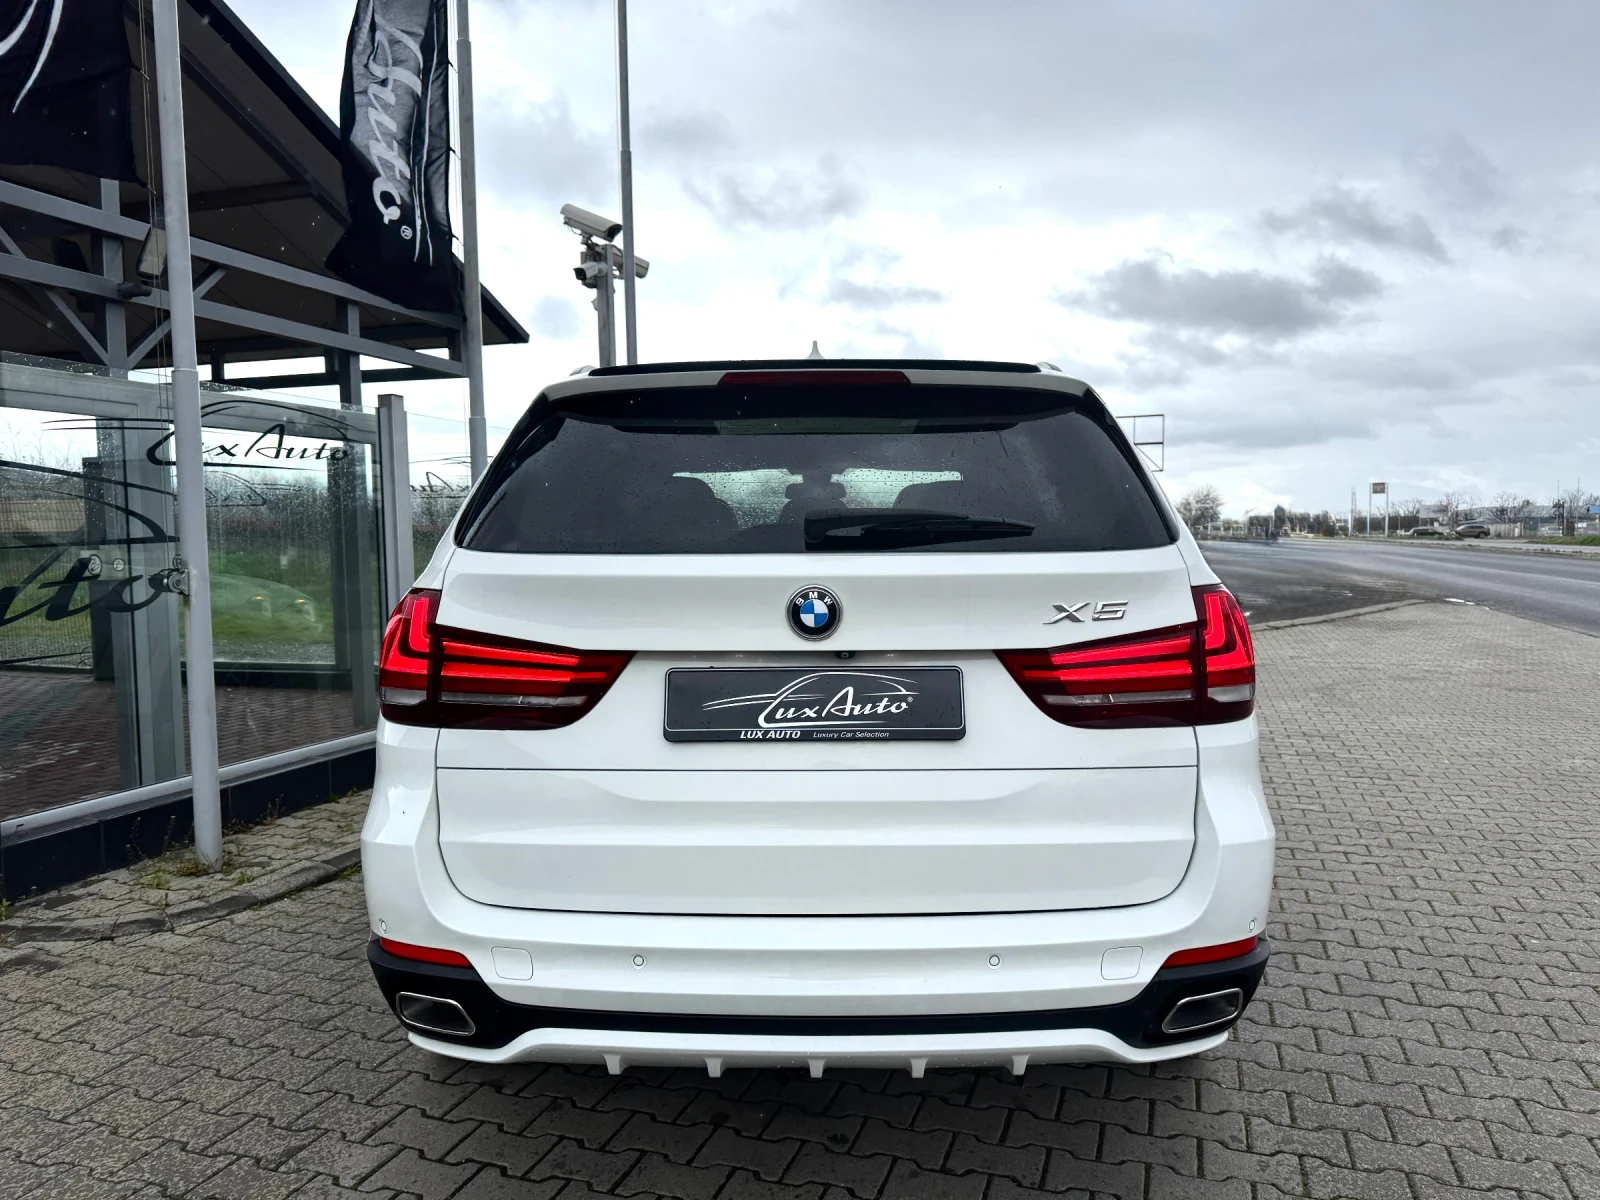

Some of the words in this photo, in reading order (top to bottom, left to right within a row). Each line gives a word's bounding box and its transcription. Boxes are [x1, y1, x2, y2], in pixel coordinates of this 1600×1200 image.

[795, 591, 833, 607] BMW
[1042, 600, 1129, 624] X5
[740, 730, 763, 739] LUX
[766, 730, 801, 739] AUTO
[813, 731, 839, 739] Luxury
